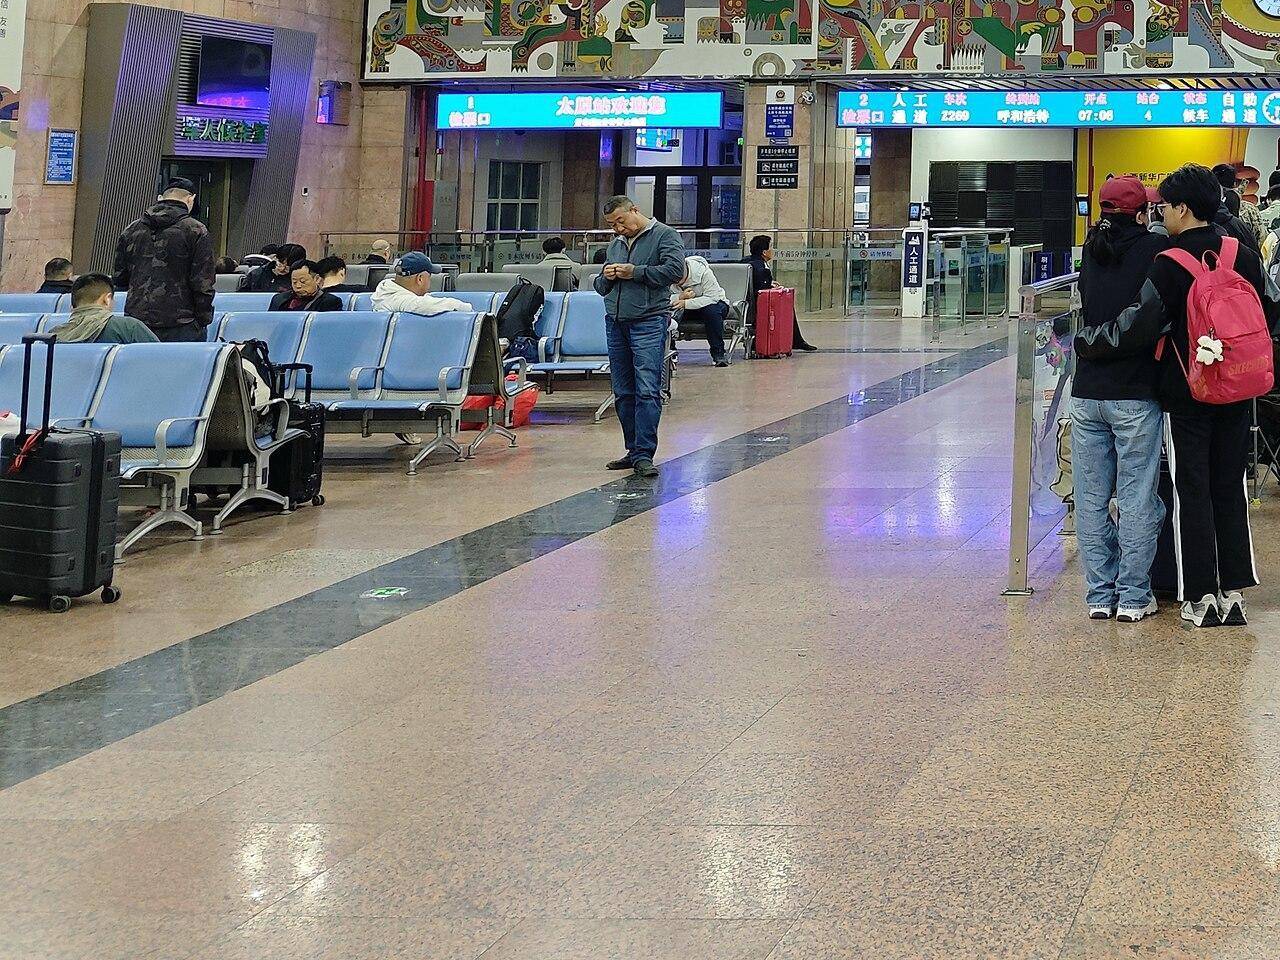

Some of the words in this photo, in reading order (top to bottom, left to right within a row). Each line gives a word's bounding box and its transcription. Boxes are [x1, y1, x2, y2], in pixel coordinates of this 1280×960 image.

[557, 96, 667, 115] 太原站欢迎您
[859, 93, 868, 106] 2
[944, 93, 967, 105] 车次
[1084, 93, 1107, 105] 开点
[1136, 93, 1159, 105] 站台
[842, 109, 884, 124] 检票口
[997, 109, 1050, 123] 呼和浩特
[1144, 108, 1152, 122] 4
[908, 246, 918, 284] 人工通道
